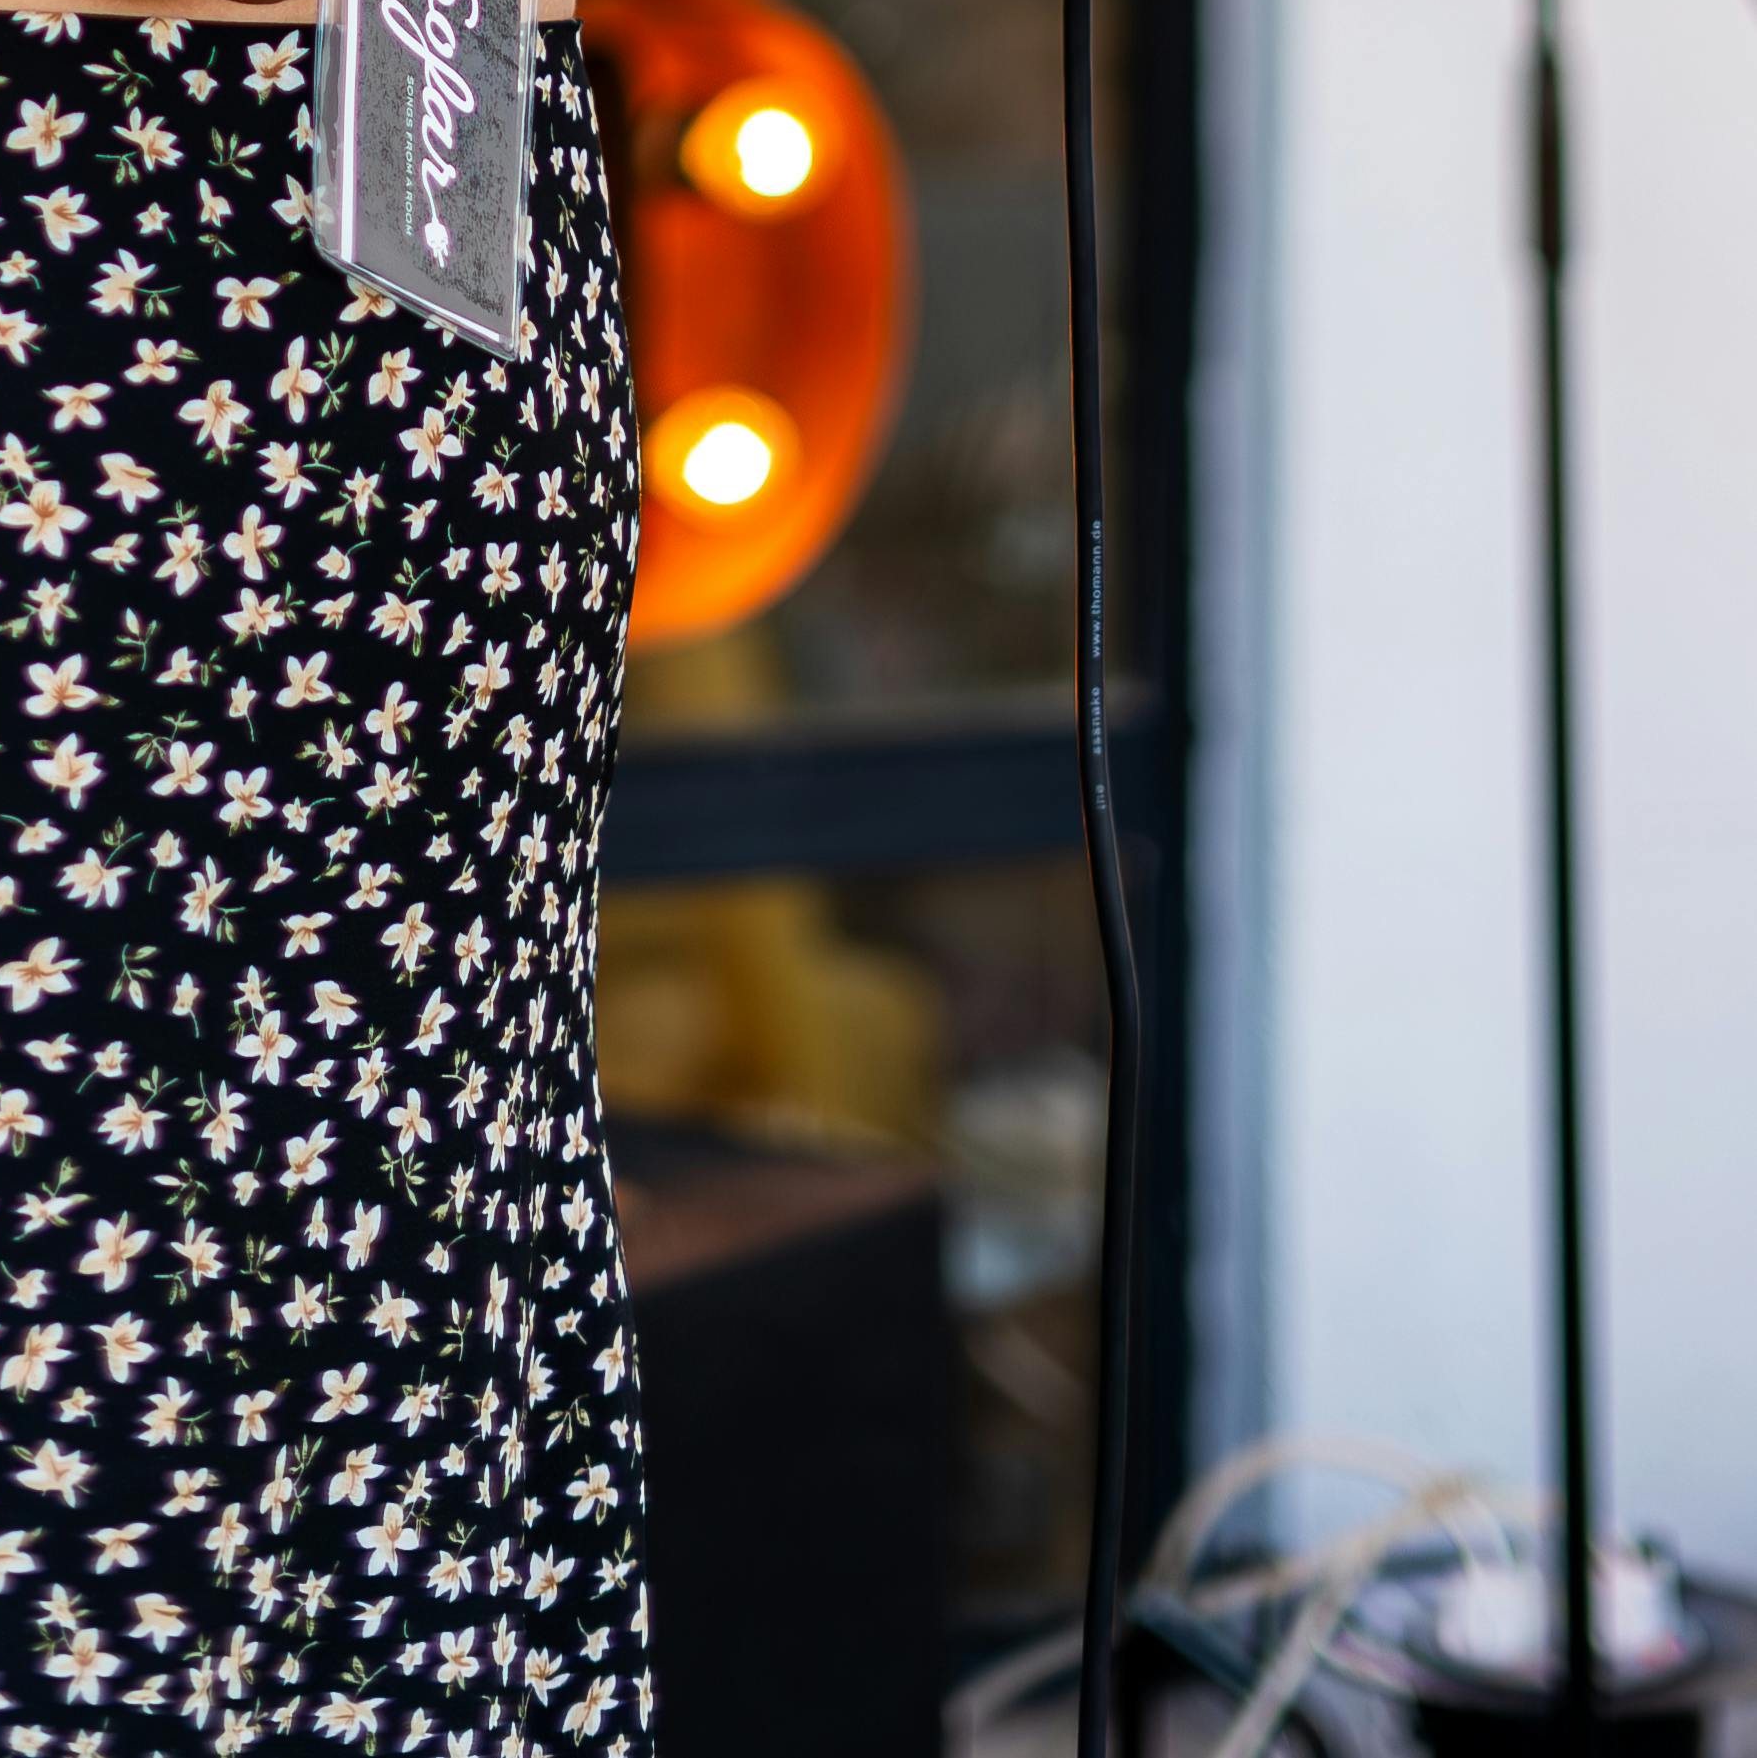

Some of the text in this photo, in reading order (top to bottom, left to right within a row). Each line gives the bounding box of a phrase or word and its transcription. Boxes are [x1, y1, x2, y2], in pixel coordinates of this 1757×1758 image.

[405, 74, 415, 237] SONGS FROM A ROOM
[1091, 519, 1102, 659] www.thomann.de
